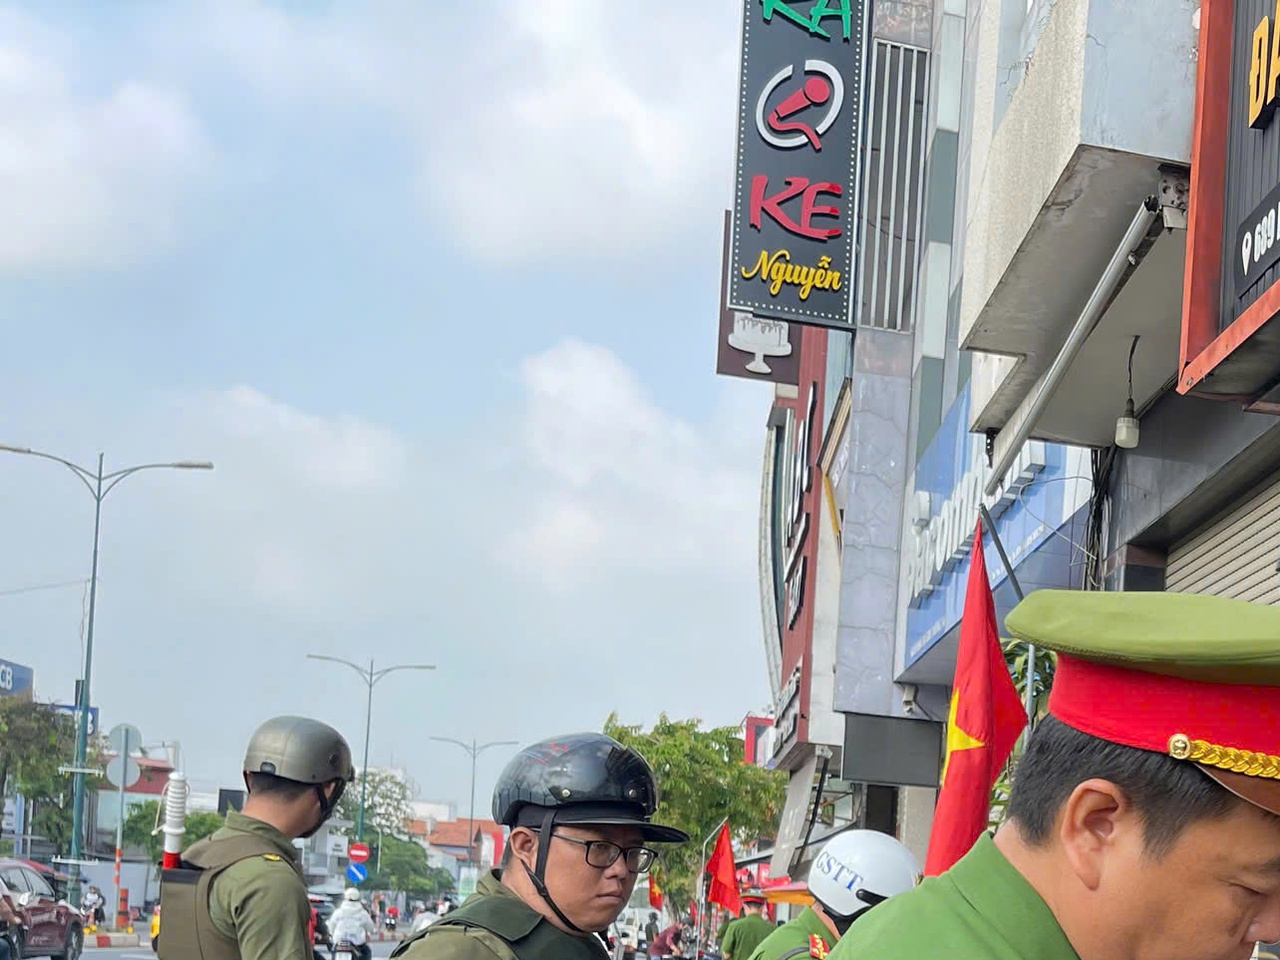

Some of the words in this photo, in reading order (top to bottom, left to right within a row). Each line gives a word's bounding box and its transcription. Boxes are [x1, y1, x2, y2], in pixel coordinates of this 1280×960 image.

[749, 175, 842, 241] KE
[1254, 213, 1276, 262] 689
[741, 249, 842, 301] Nguyễn
[817, 851, 864, 892] CSTT
